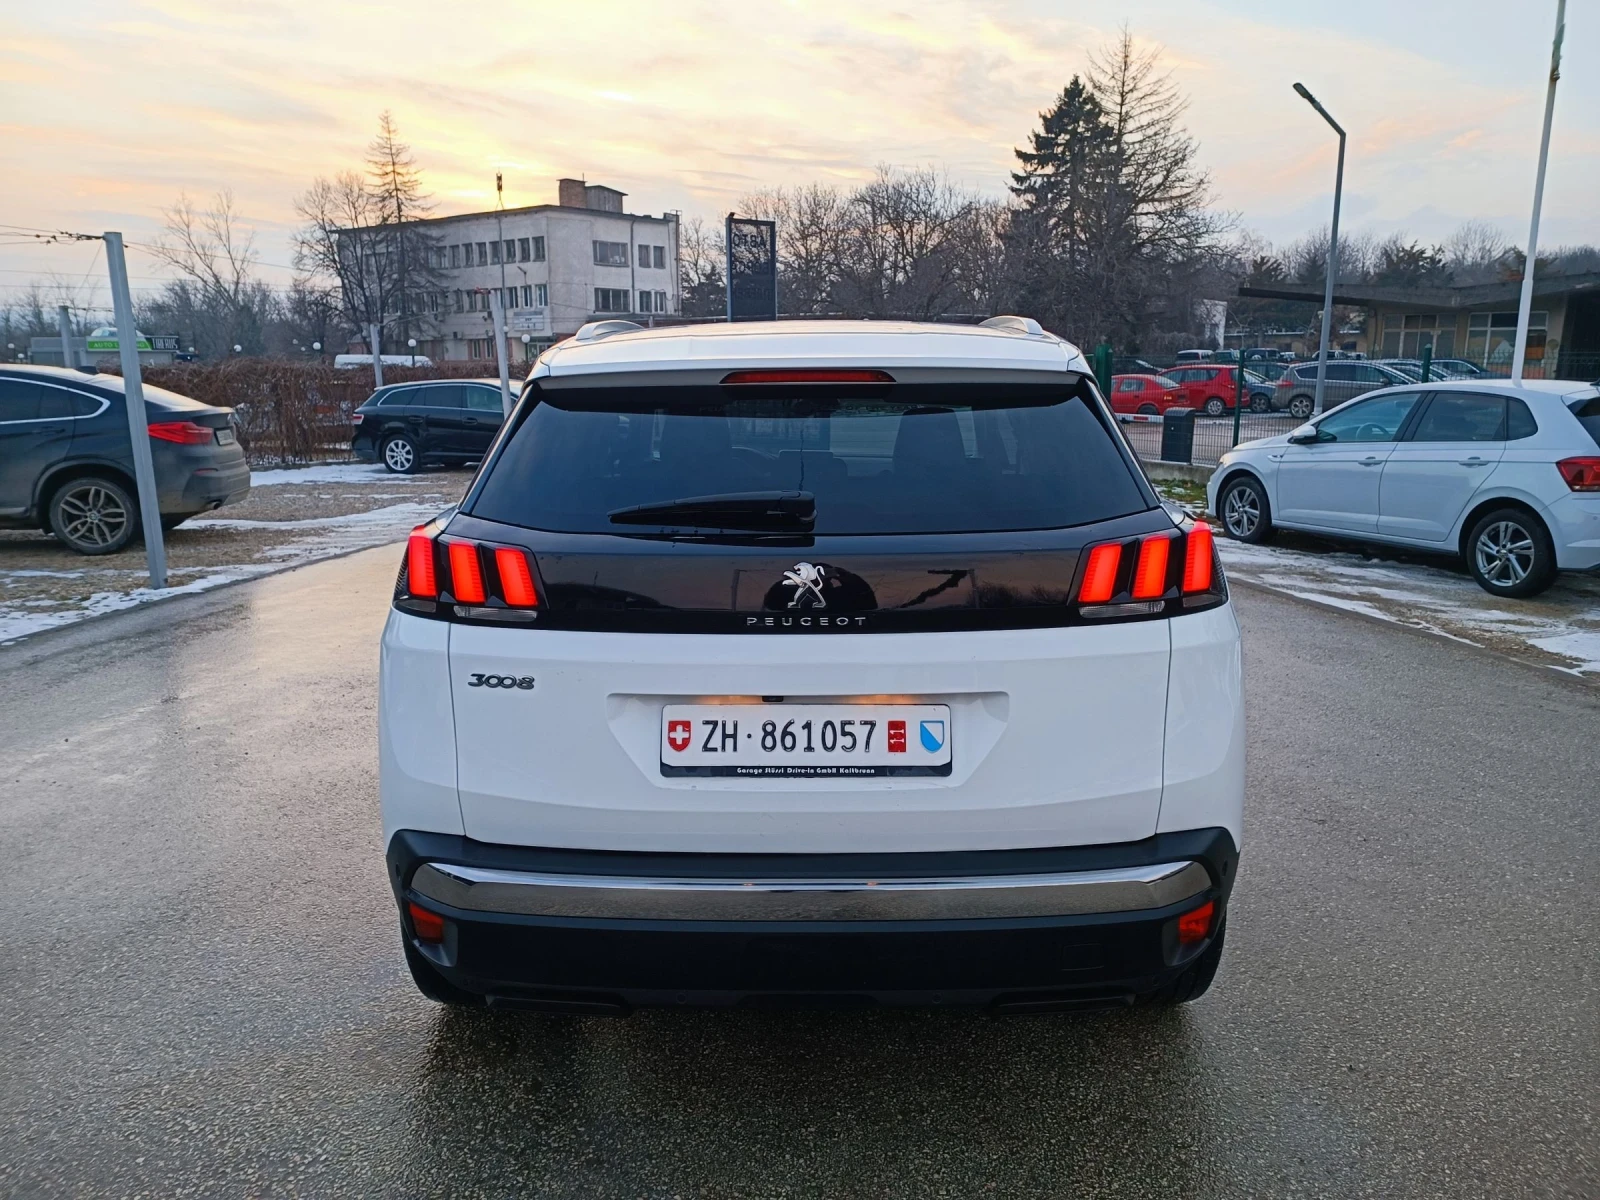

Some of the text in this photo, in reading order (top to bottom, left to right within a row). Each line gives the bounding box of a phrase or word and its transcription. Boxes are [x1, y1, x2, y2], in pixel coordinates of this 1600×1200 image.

[746, 616, 867, 626] PEUGEOT
[467, 673, 536, 690] 3008
[737, 767, 762, 775] Garage
